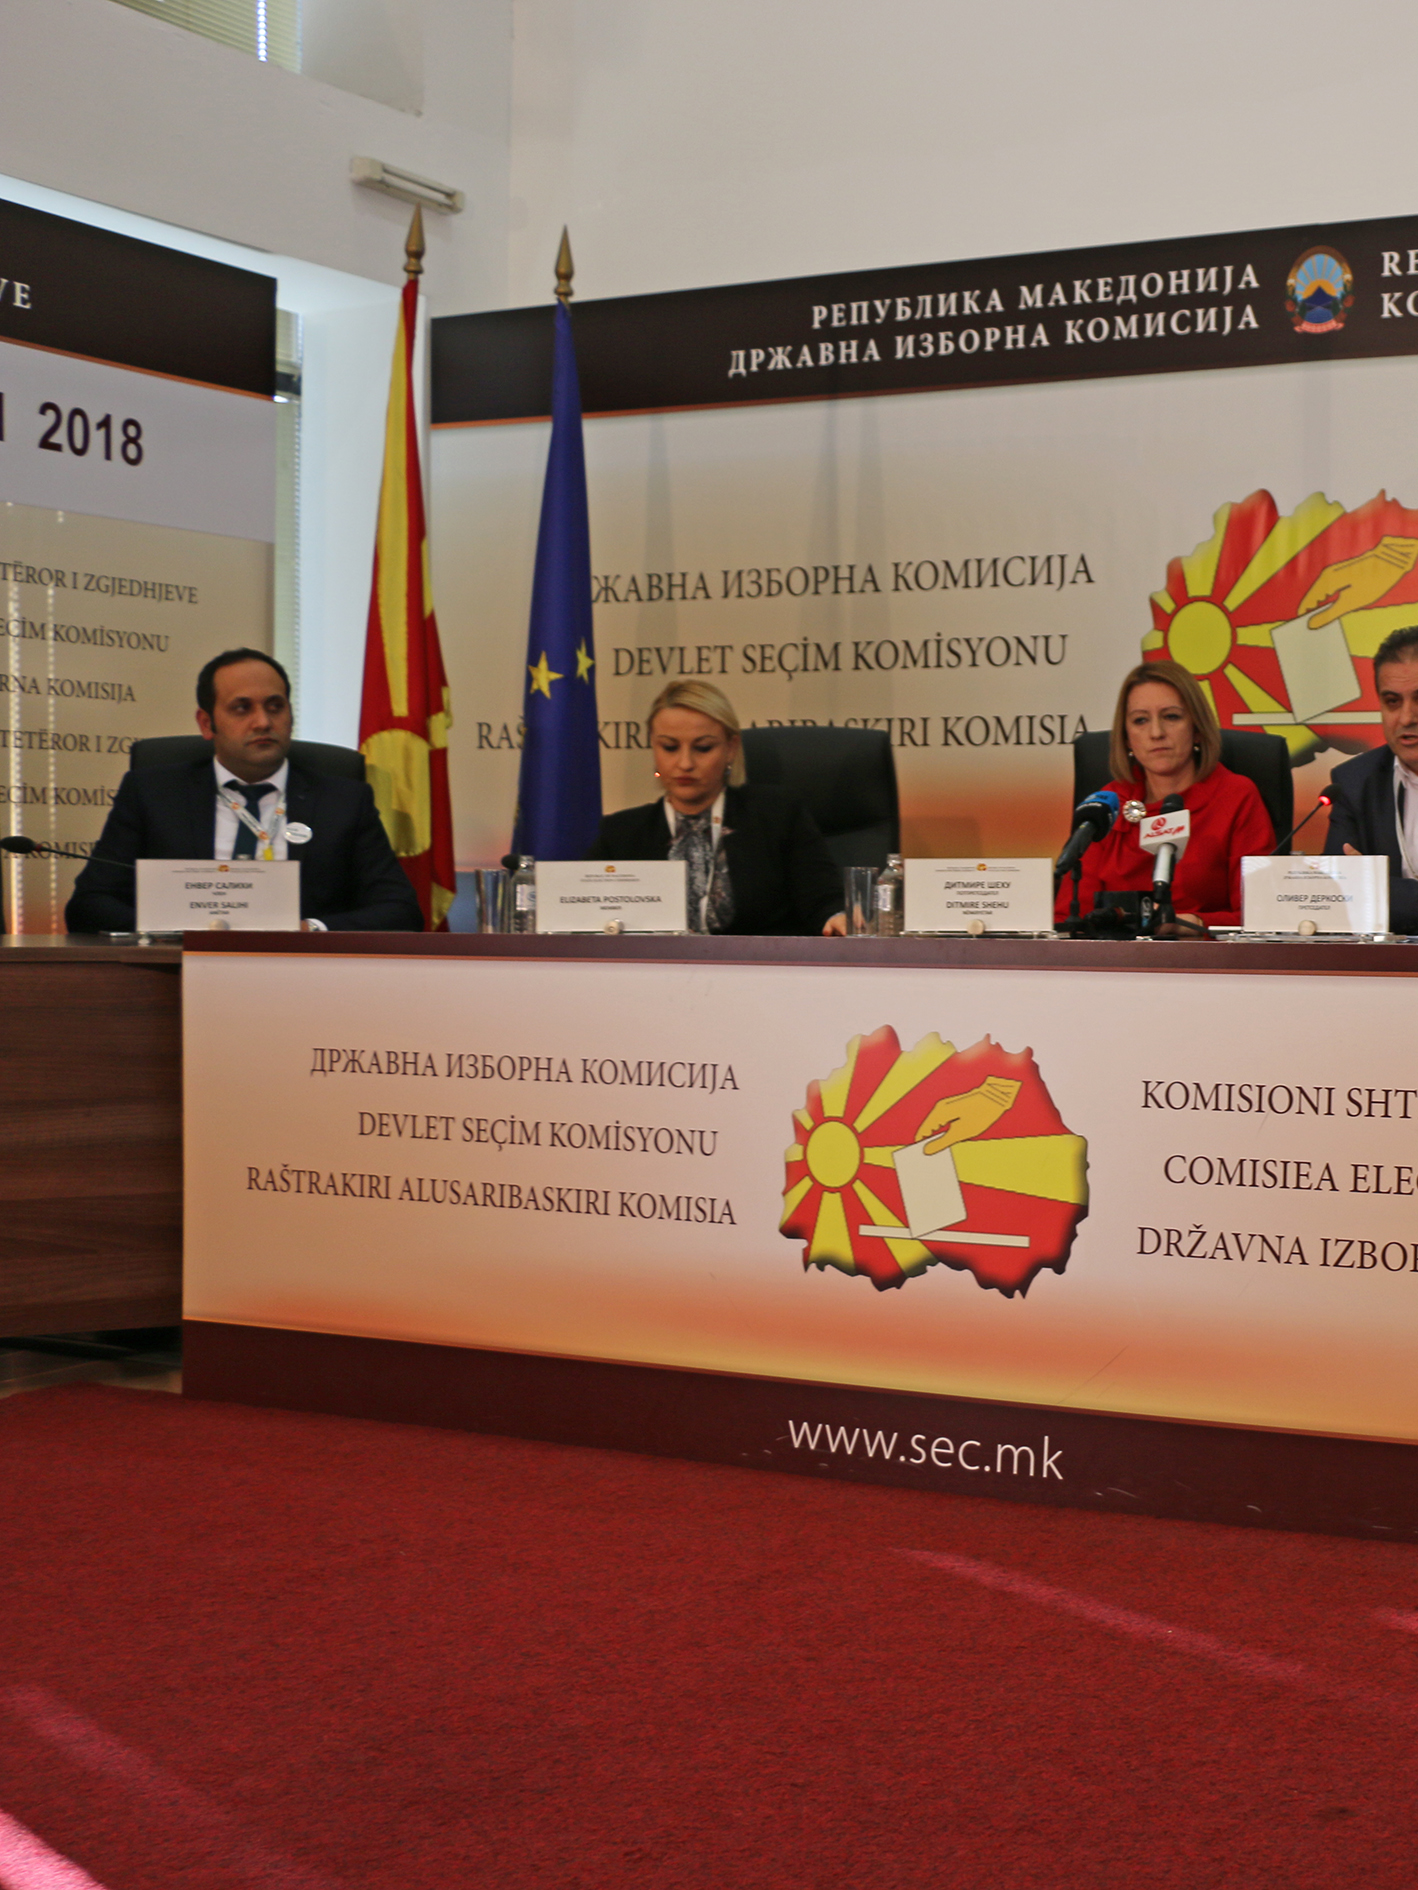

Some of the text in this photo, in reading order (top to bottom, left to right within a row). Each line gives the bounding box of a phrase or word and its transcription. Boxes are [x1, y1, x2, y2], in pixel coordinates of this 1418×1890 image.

[812, 263, 1260, 329] РЕПУБЛИКА МАКЕДОНИЈА
[728, 303, 1260, 378] ДРЖАВНА ИЗБОРНА КОМИСИЈА
[38, 401, 144, 466] 2018
[71, 571, 80, 590] I
[83, 572, 199, 604] ZGJEDHJEVE
[591, 552, 1096, 603] ЖАВНА ИЗБОРНА КОМИСИЈА
[612, 631, 1069, 682] DEVLET SEÇİM KOMİSYONU
[310, 1047, 740, 1094] ДРЖАВНА ИЗБОРНА КОМИСИЈА
[1141, 1079, 1336, 1116] KOMISIONI
[358, 1111, 718, 1157] DEVLET SEÇİM KOMİSYONU
[246, 1163, 737, 1225] RAŠTRAKIRI ALUSARIBASKIRI KOMISIA
[1163, 1154, 1340, 1192] COMISIEA
[1137, 1223, 1310, 1266] DRŽAVNA
[788, 1419, 1063, 1480] www.sec.mk
